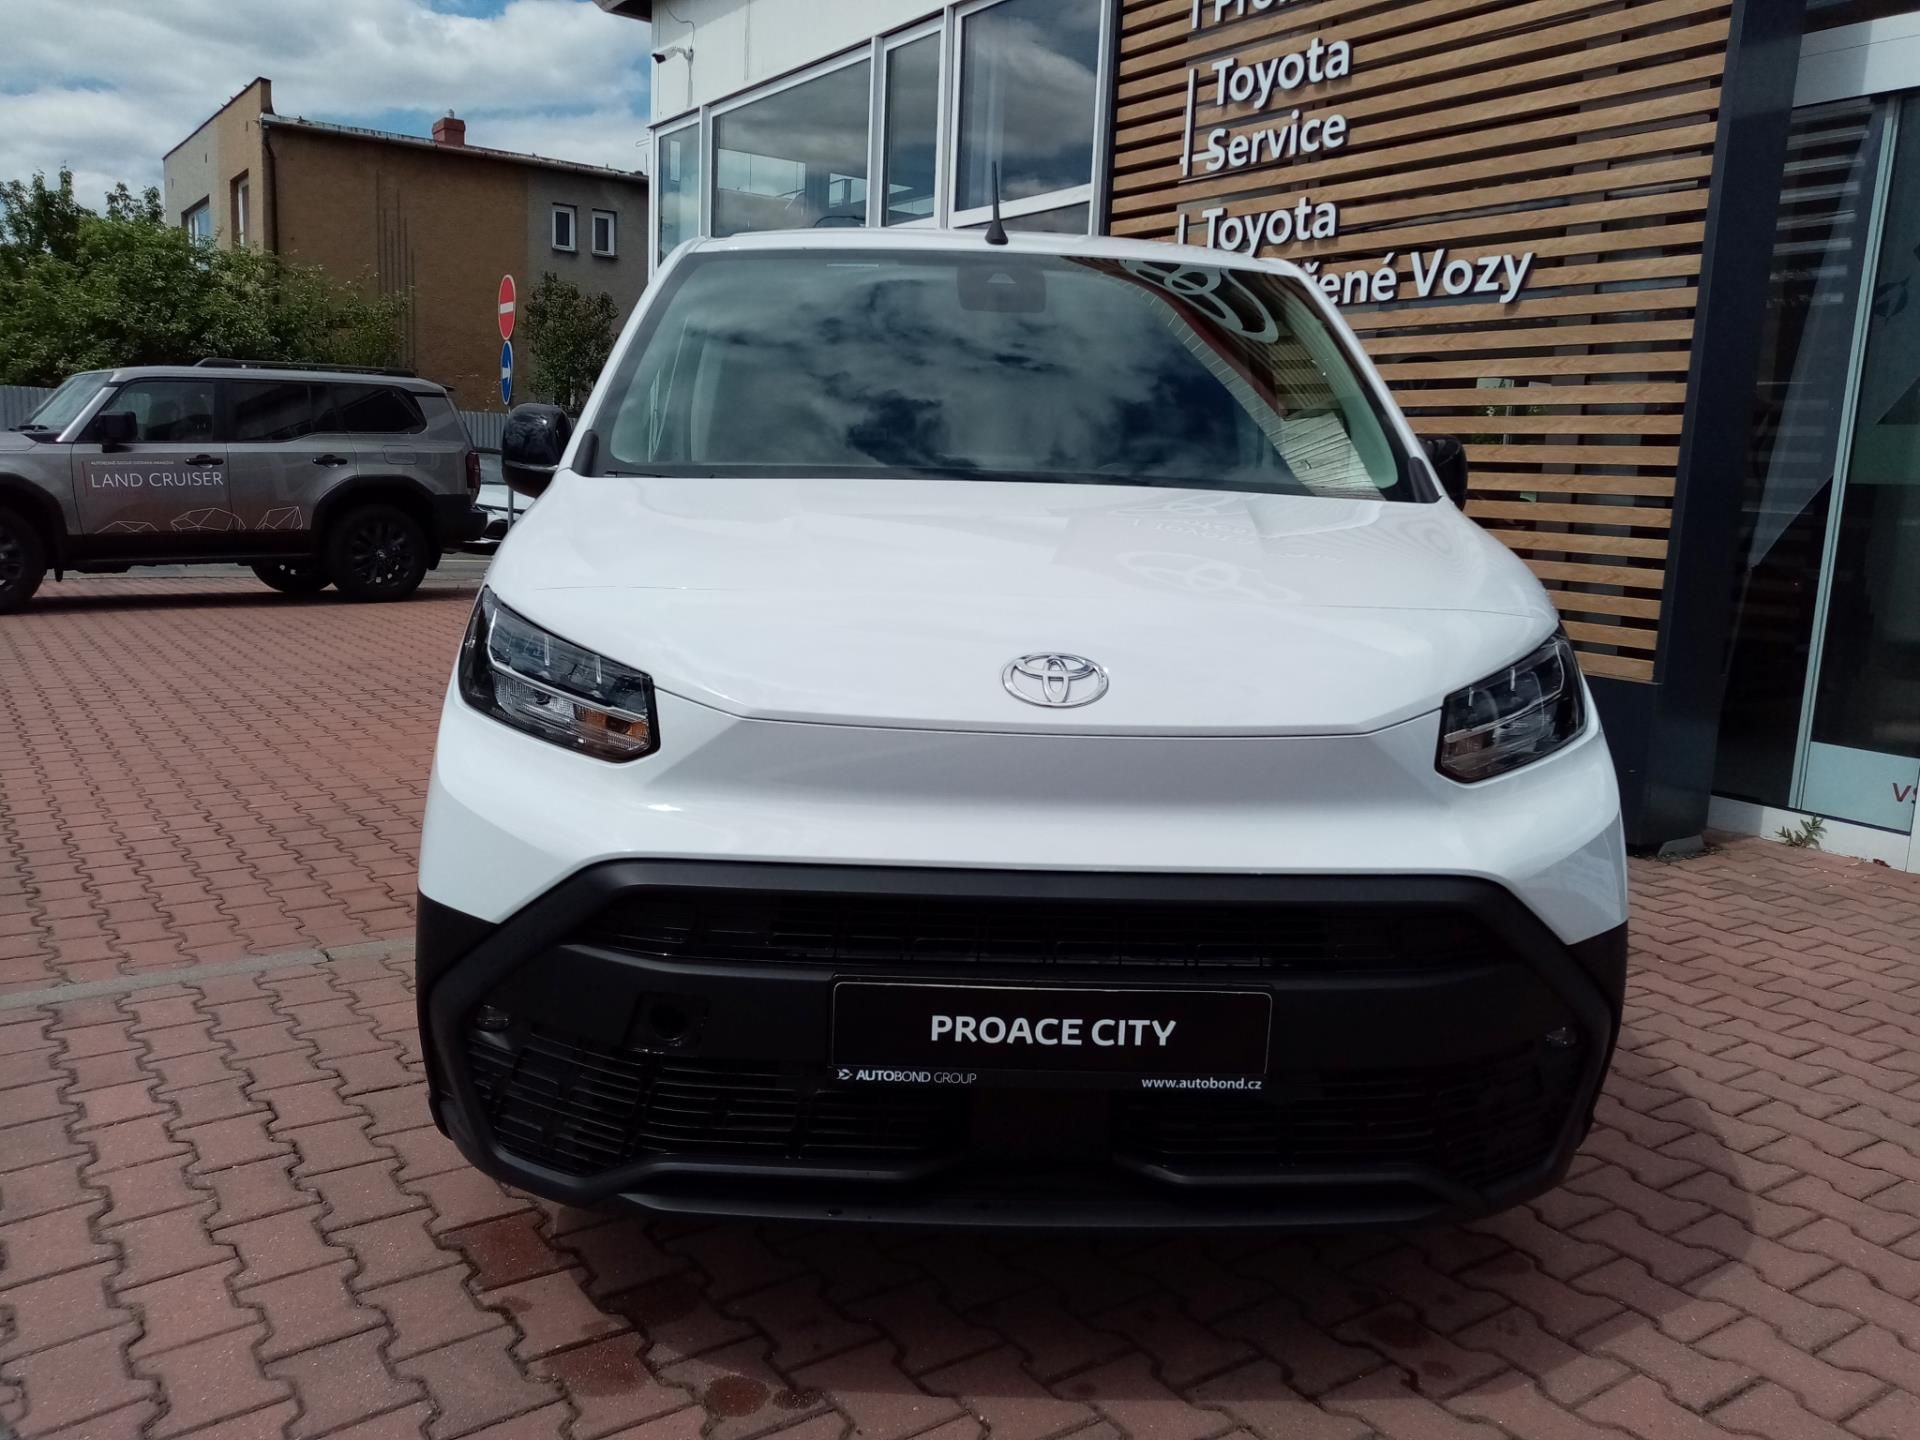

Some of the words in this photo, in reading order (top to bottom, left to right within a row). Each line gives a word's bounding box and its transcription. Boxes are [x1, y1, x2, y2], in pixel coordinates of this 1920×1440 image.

[1211, 37, 1351, 109] Toyota
[1205, 109, 1348, 173] Service
[1201, 197, 1338, 258] Toyota
[1410, 248, 1535, 303] Vozy
[90, 472, 144, 489] LAND
[148, 471, 224, 488] CRUISER
[930, 1014, 1083, 1046] PROACE
[1091, 1018, 1177, 1047] CITY
[855, 1069, 931, 1083] AUTOBOND
[933, 1071, 977, 1085] GROUP
[1141, 1075, 1263, 1091] www.autobond.cz
